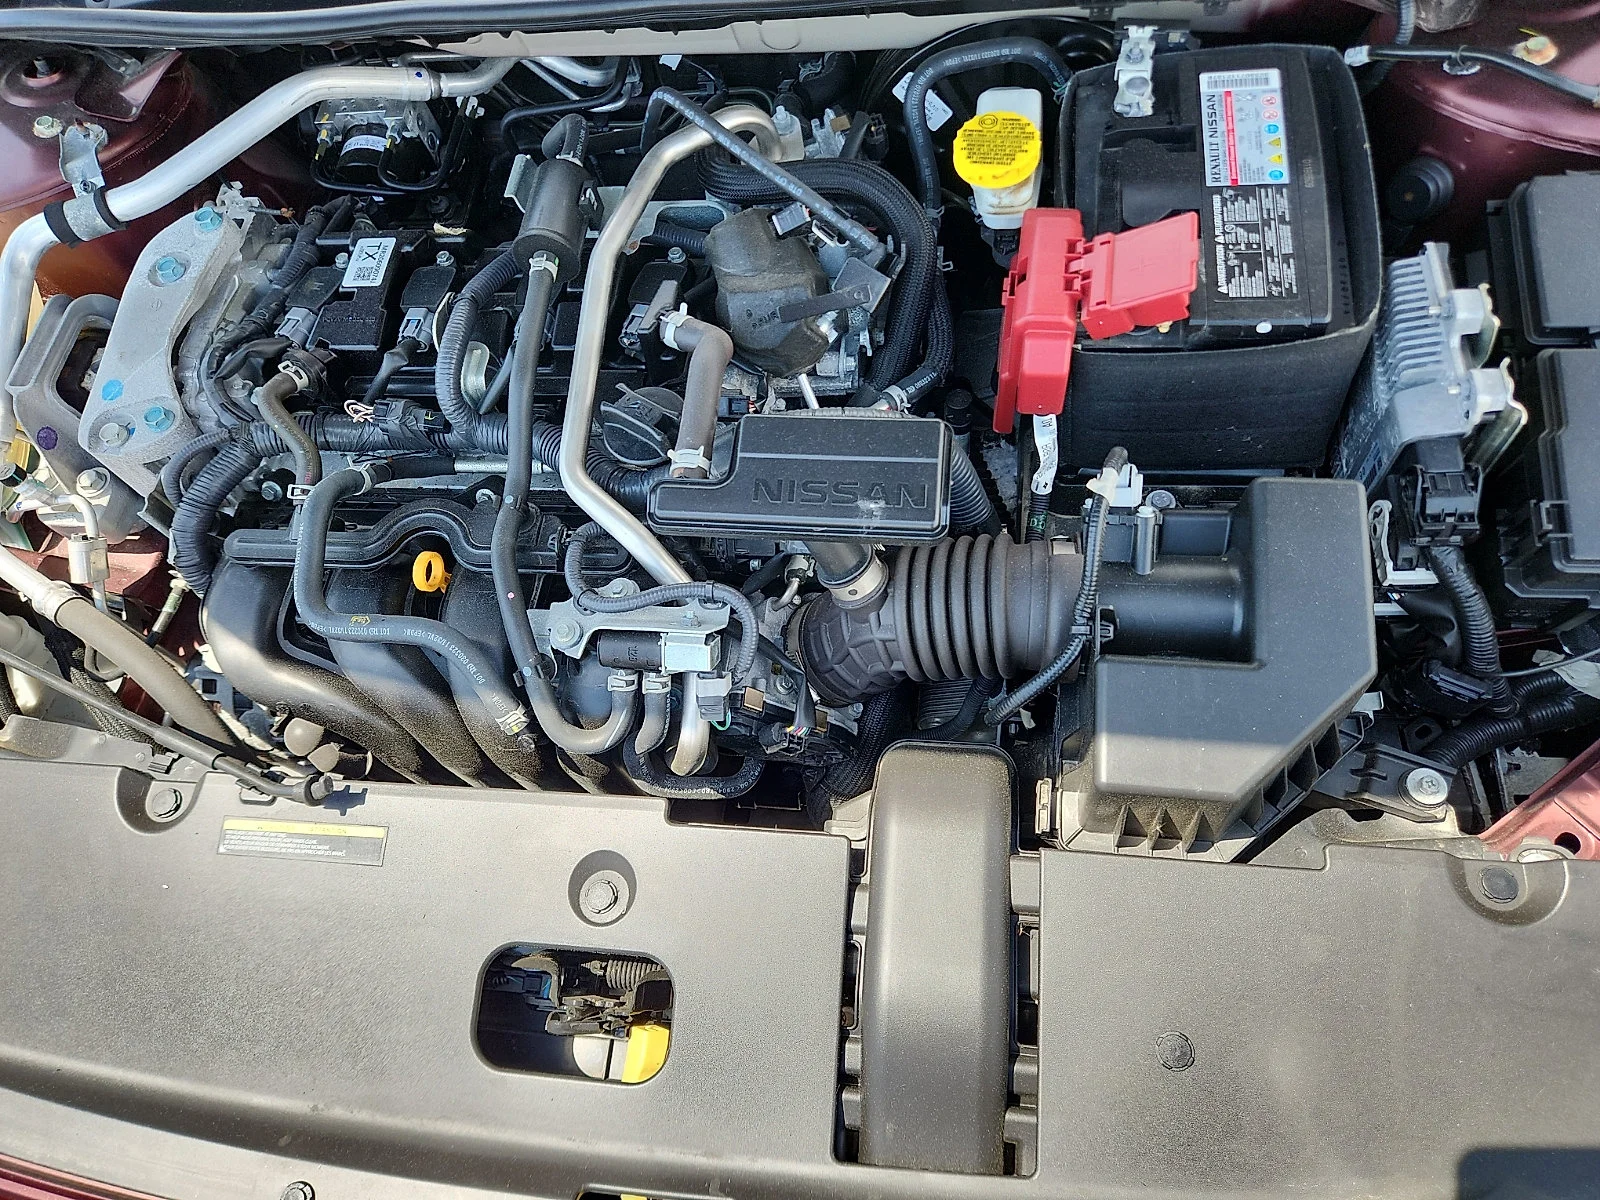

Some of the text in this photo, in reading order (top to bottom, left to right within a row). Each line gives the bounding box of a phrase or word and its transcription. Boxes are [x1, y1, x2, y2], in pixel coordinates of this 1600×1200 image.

[1206, 94, 1221, 184] RENAULT NISSAN
[361, 241, 383, 262] TX
[751, 477, 928, 509] NISSAN
[473, 671, 485, 684] DOT
